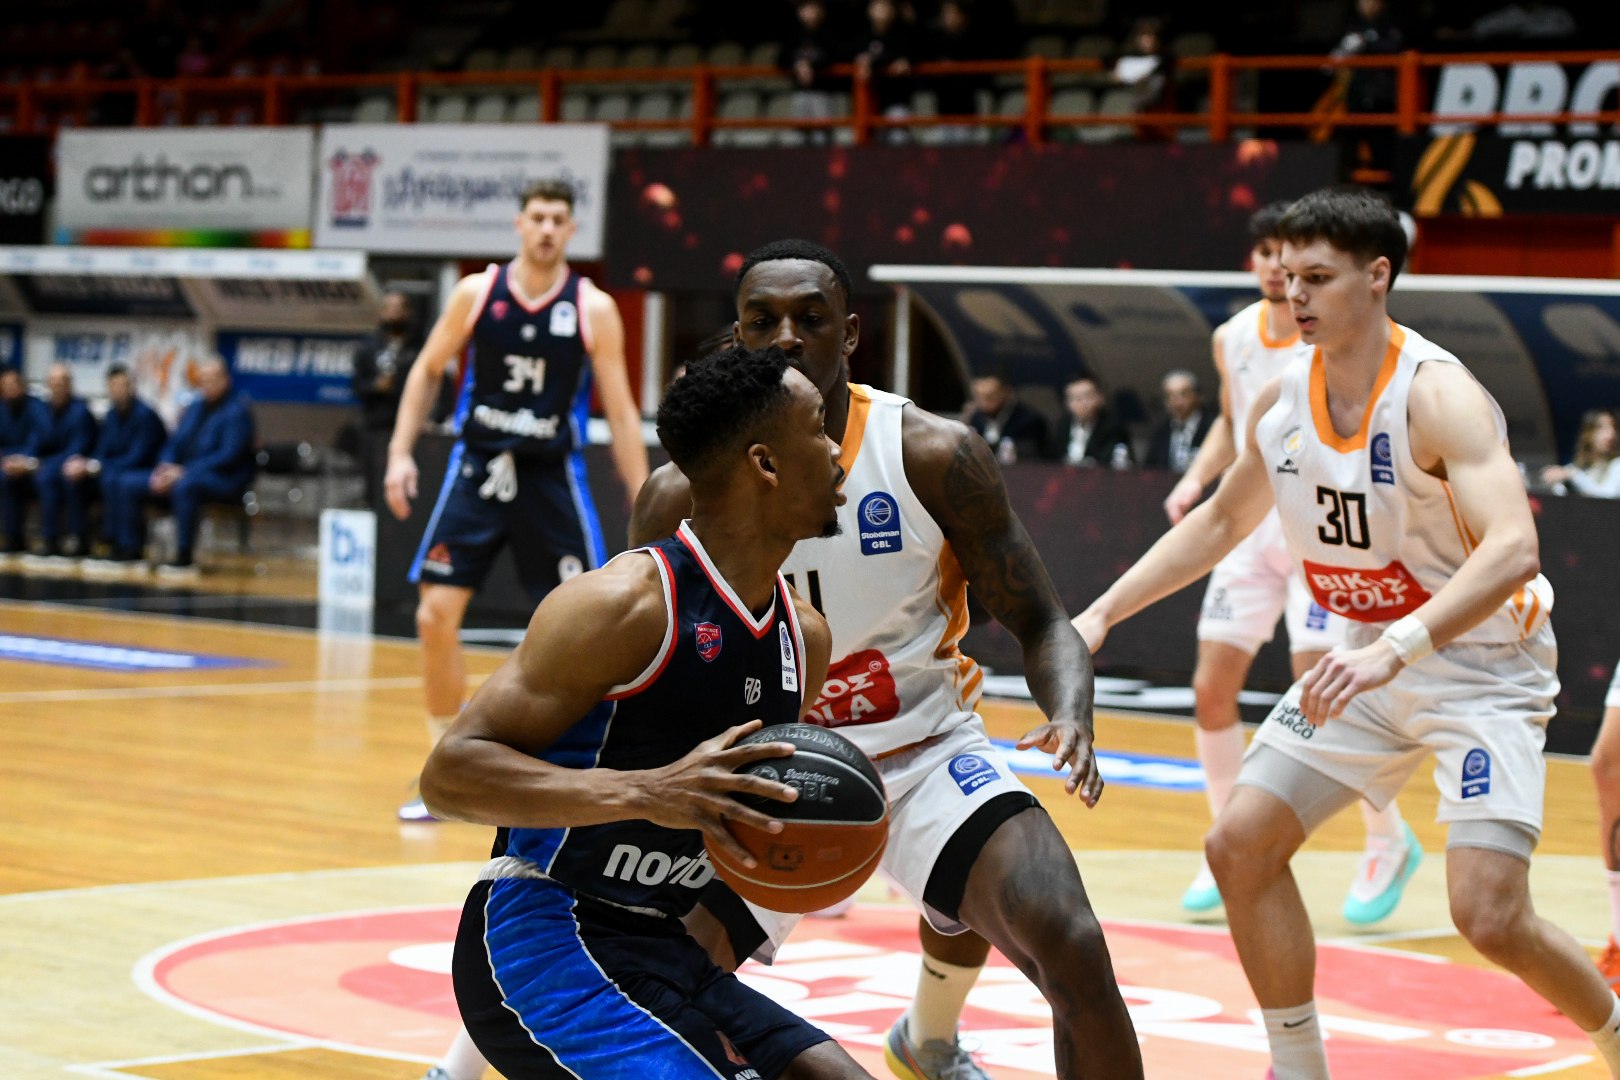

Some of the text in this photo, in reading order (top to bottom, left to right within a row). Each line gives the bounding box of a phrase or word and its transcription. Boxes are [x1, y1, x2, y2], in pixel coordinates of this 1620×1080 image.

[83, 153, 252, 201] arthon
[503, 354, 546, 395] 34
[1317, 485, 1371, 550] 30
[872, 540, 891, 548] GBL
